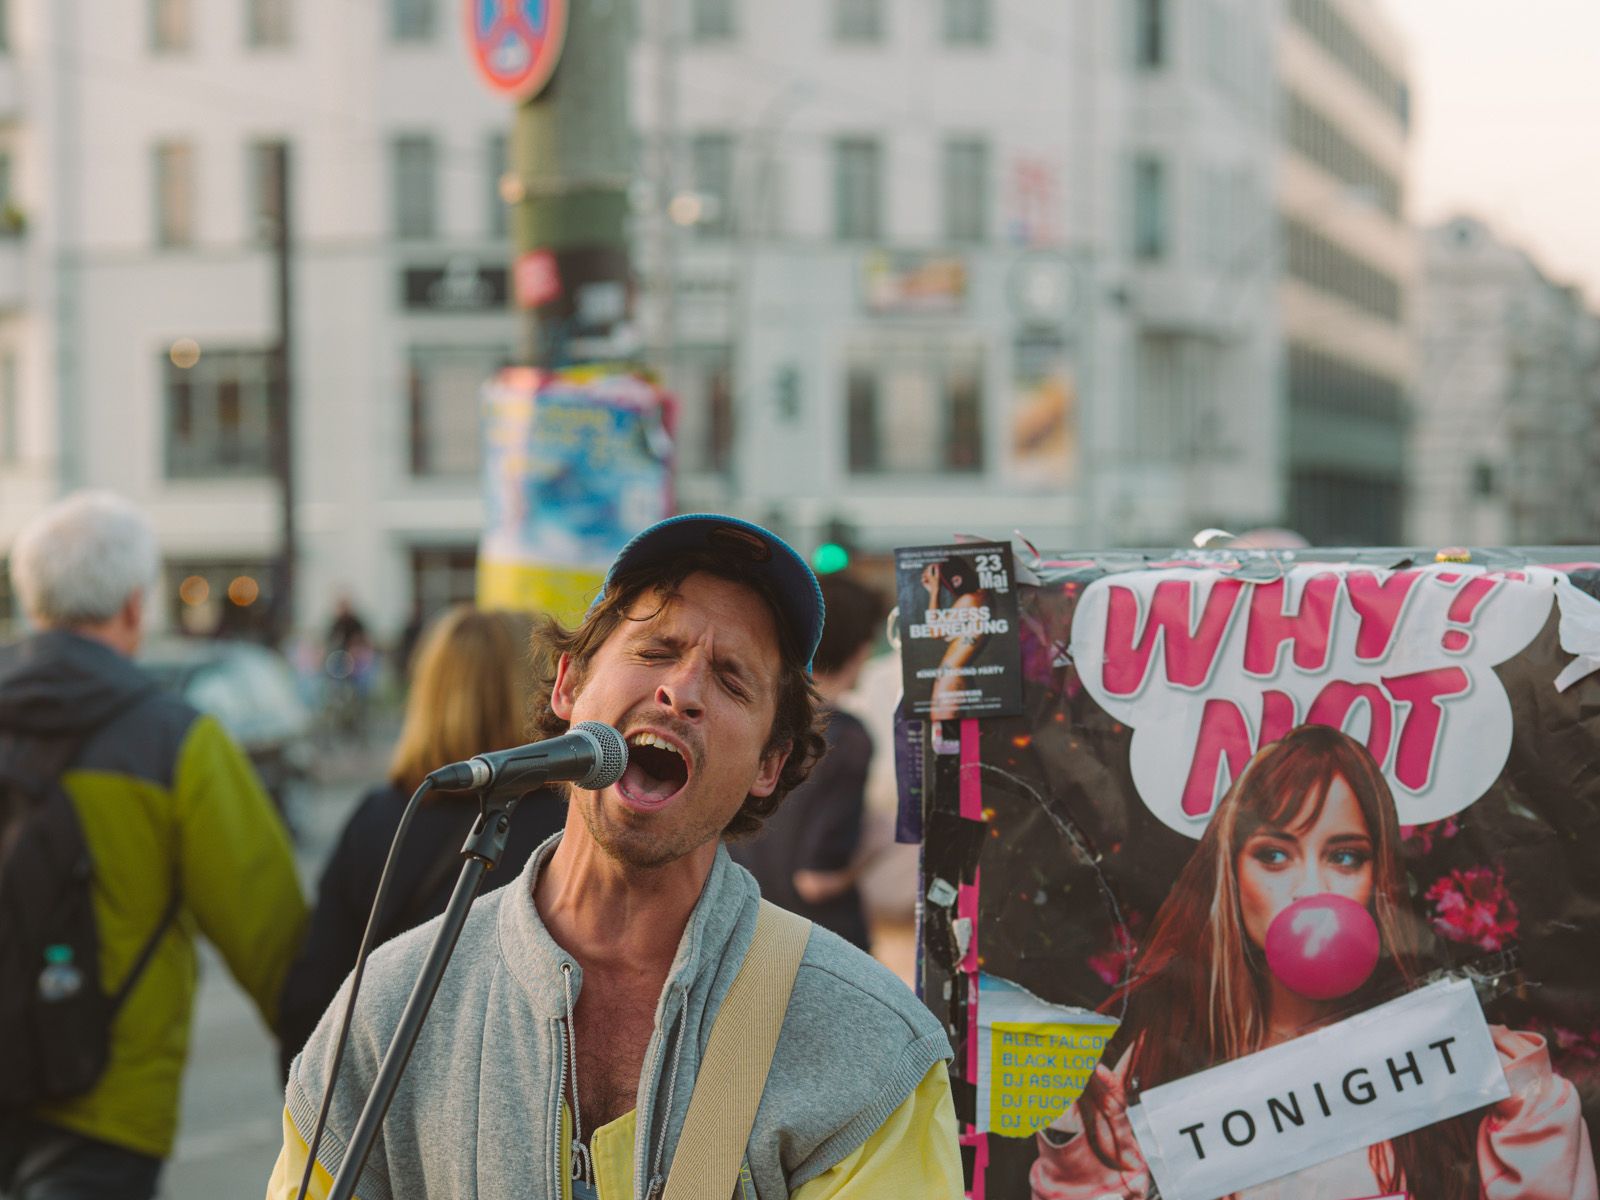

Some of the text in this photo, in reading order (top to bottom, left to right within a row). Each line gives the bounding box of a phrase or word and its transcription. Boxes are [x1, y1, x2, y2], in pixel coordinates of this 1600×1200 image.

[975, 554, 1002, 573] 23
[979, 570, 1008, 589] Mai
[925, 606, 990, 622] EXZESS
[978, 666, 1004, 675] PARTY
[1181, 666, 1469, 816] NOT
[1003, 1032, 1043, 1047] ALEC
[1003, 1053, 1056, 1068] BLACK
[1003, 1074, 1024, 1087] DJ
[1002, 1094, 1022, 1108] DJ
[1179, 1037, 1457, 1160] TONIGHT
[1001, 1114, 1021, 1128] DJ
